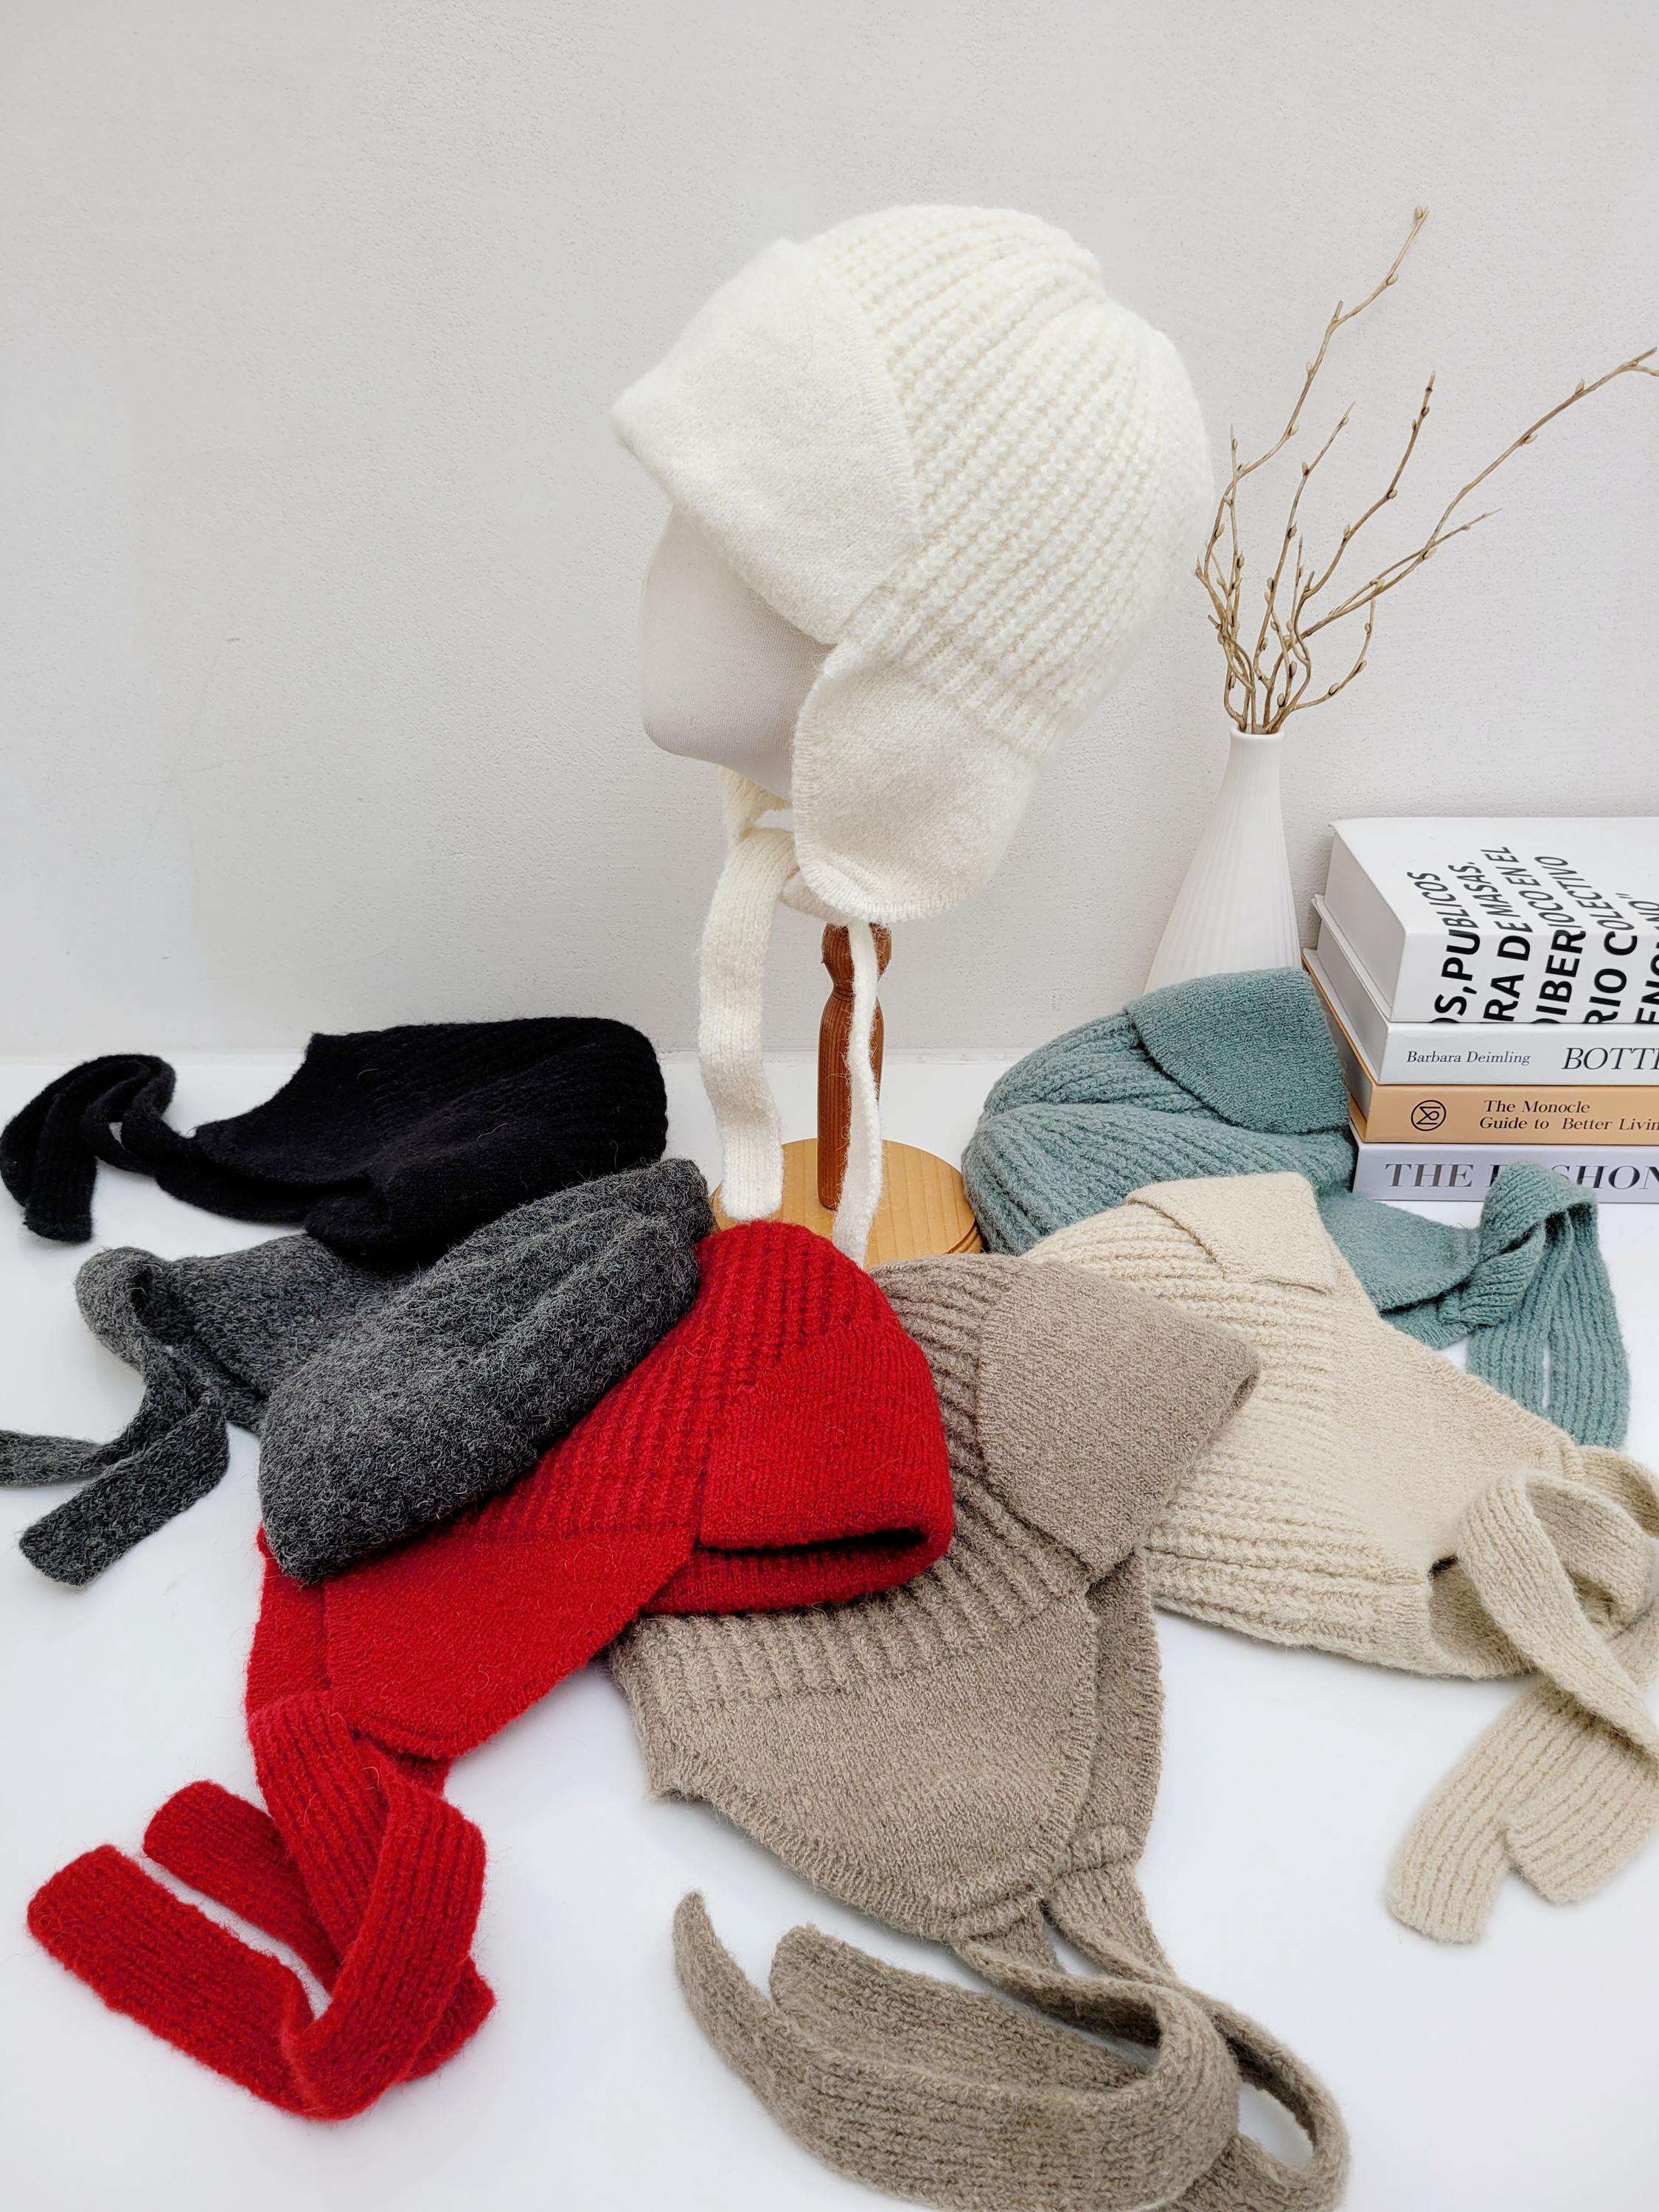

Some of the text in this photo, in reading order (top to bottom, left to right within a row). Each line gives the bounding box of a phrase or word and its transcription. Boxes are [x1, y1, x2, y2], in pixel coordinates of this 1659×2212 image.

[1480, 846, 1520, 863] EL
[1495, 866, 1541, 886] EN
[1447, 862, 1521, 918] MASAS.
[1534, 856, 1638, 956] COLECTIVO
[1494, 921, 1534, 961] DE
[1405, 1051, 1462, 1063] Barbara
[1466, 1051, 1531, 1066] Deimling
[1483, 1099, 1590, 1113] The Monocle
[1479, 1117, 1528, 1130] Guide
[1534, 1118, 1550, 1130] to
[1562, 1117, 1613, 1130] Better
[1385, 1163, 1474, 1188] THE
